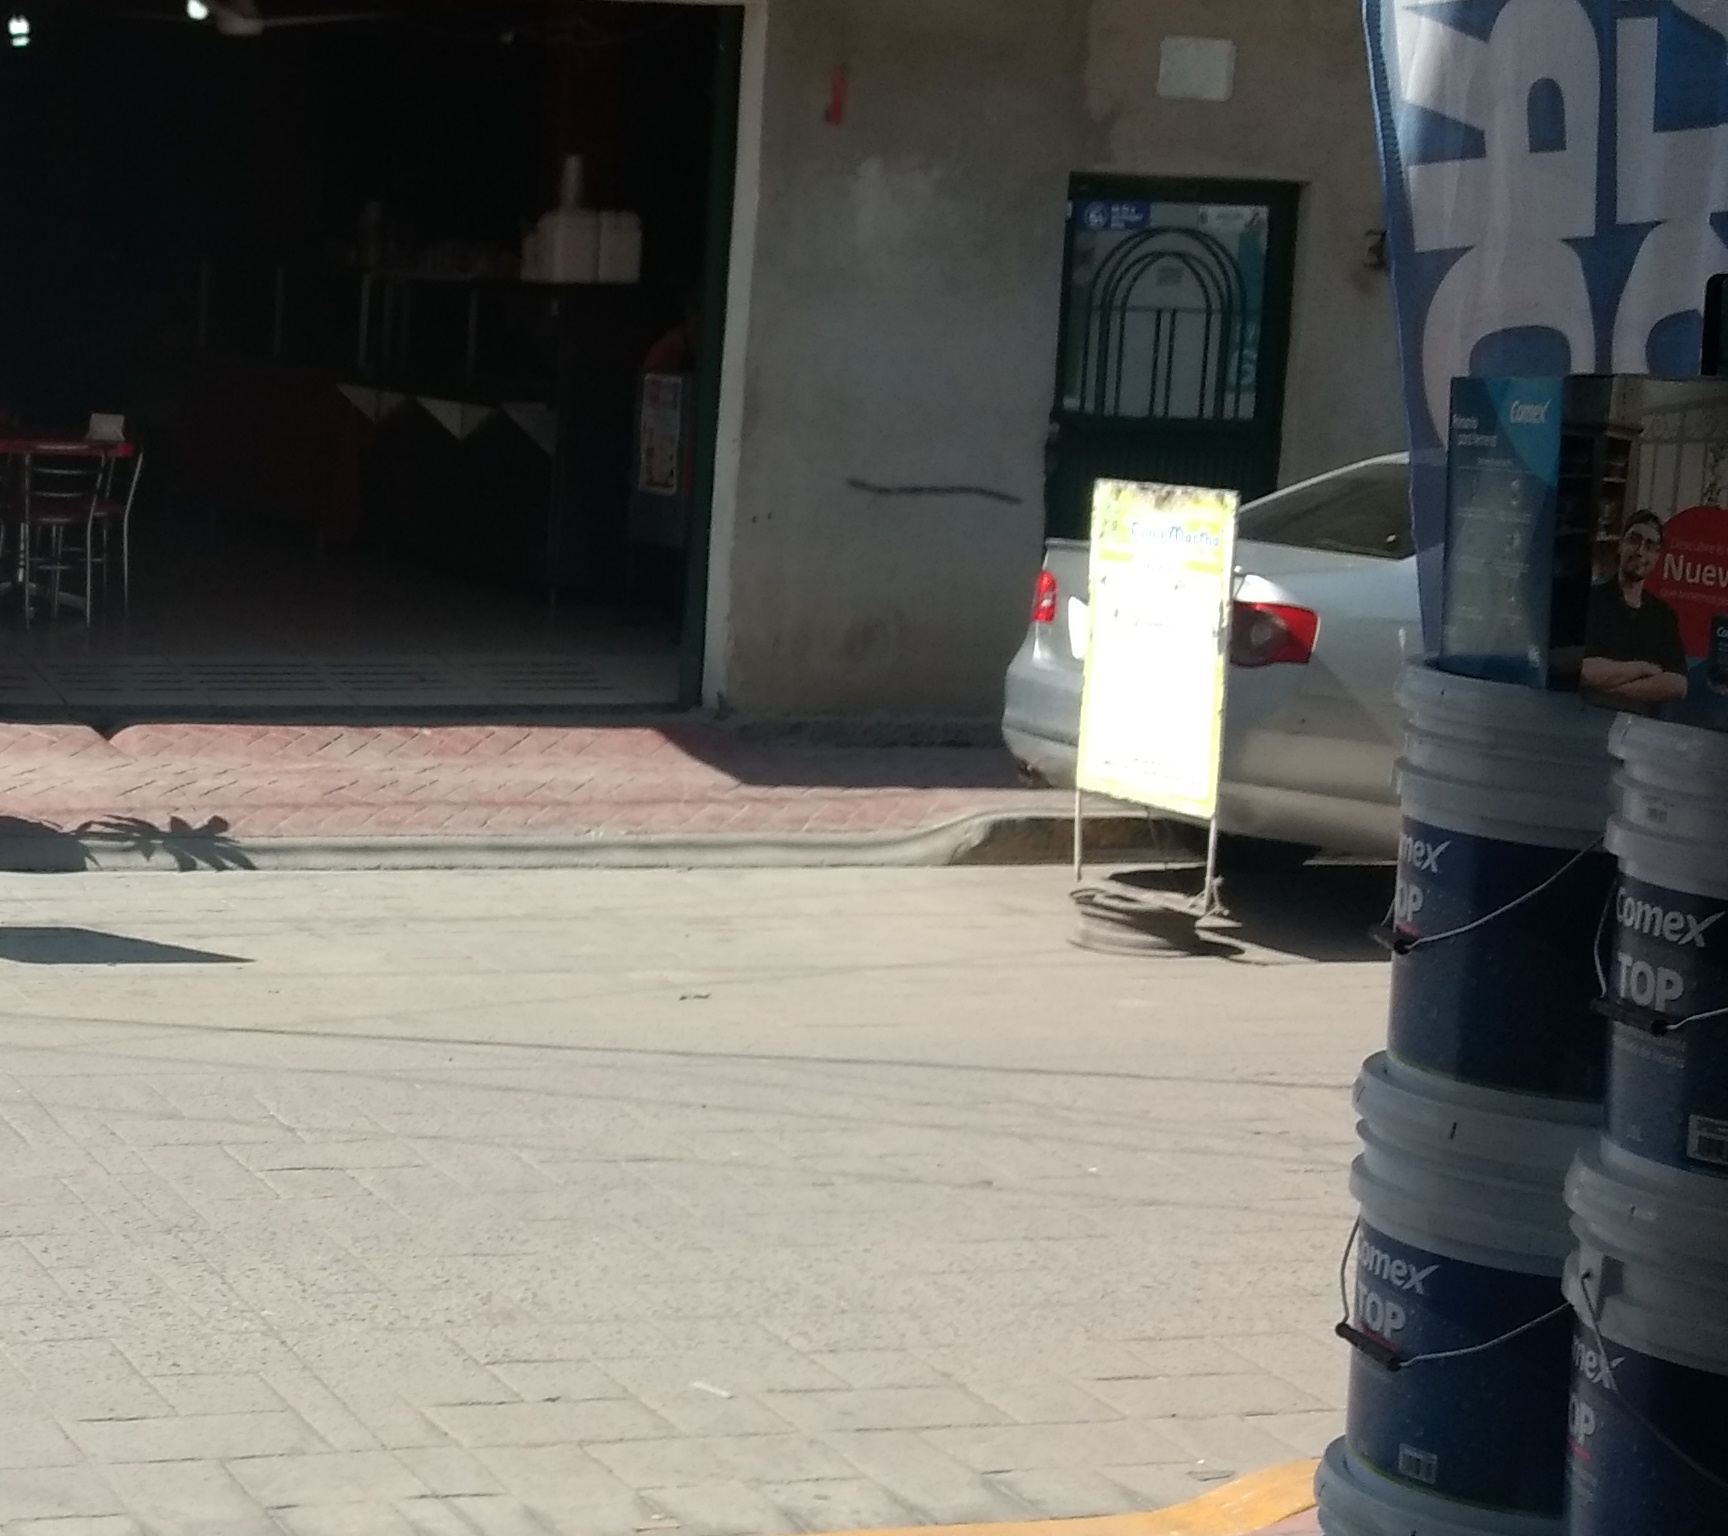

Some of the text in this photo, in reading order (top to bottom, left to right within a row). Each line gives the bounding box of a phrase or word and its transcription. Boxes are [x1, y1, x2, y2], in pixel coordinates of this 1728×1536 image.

[1400, 834, 1452, 873] mex
[1395, 880, 1424, 922] OP
[1616, 886, 1726, 948] Comex
[1618, 952, 1684, 1011] TOP
[1362, 1240, 1440, 1295] omex
[1568, 1393, 1596, 1445] OP
